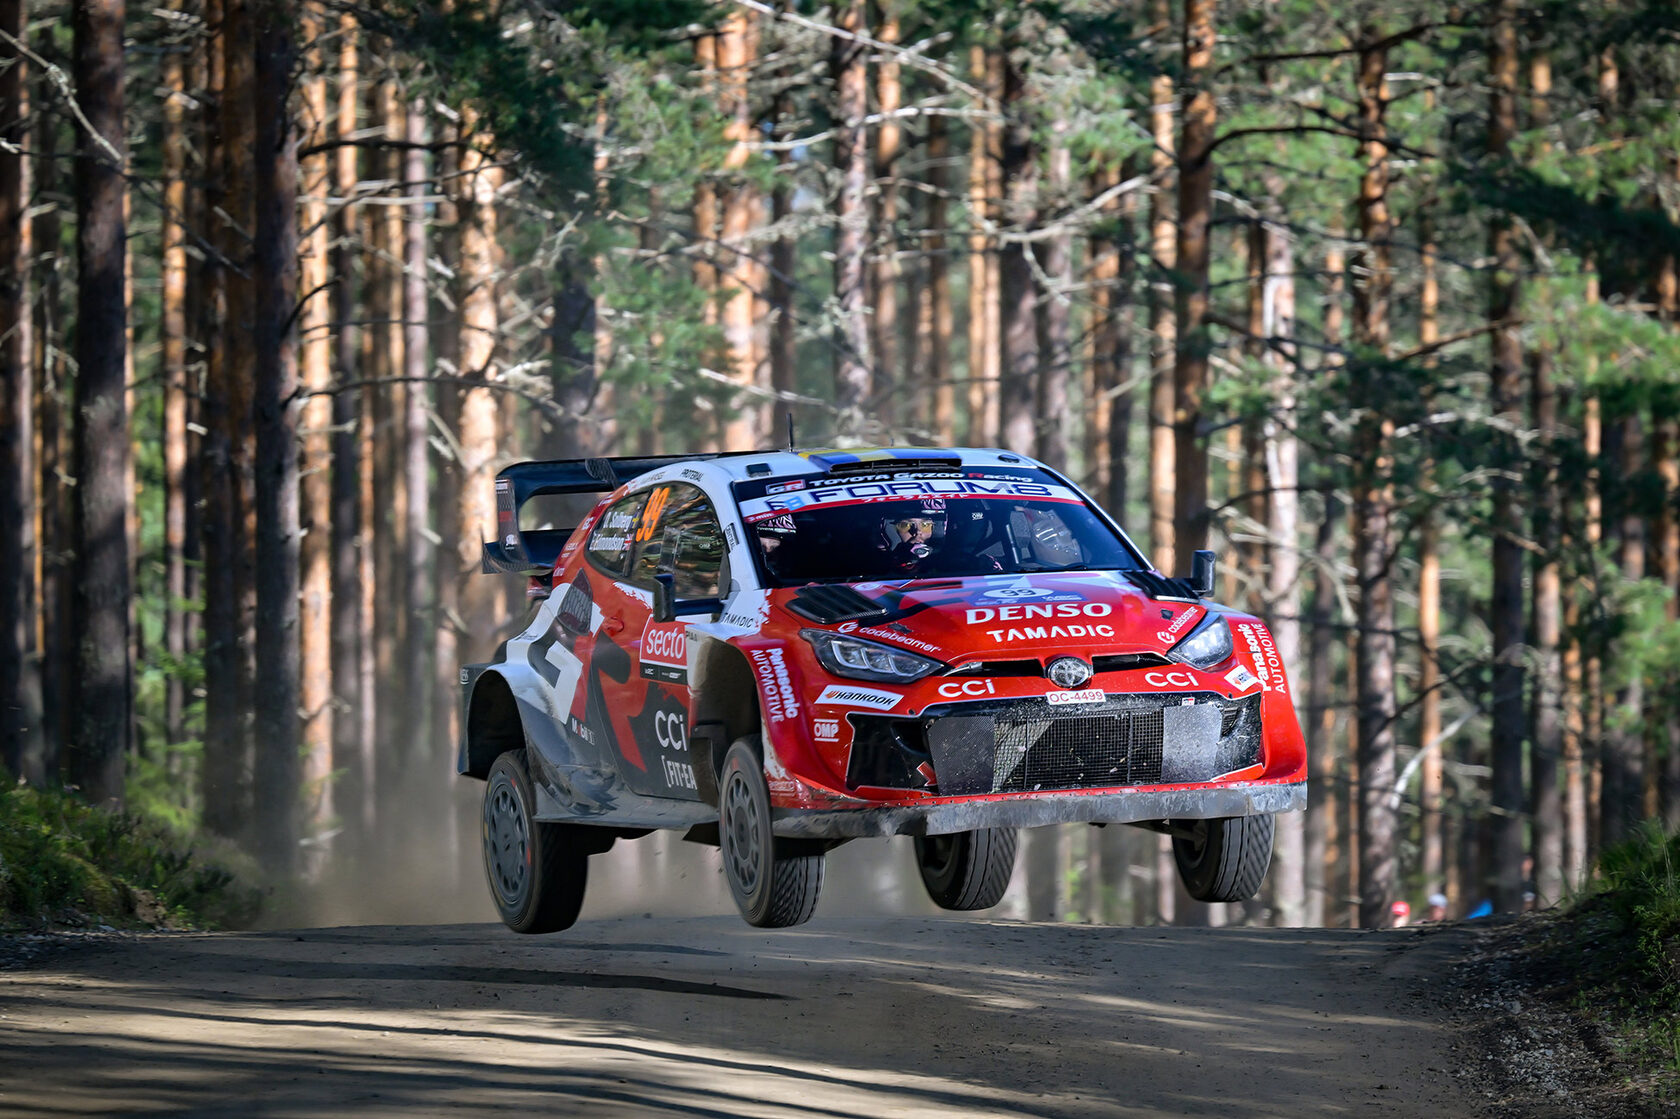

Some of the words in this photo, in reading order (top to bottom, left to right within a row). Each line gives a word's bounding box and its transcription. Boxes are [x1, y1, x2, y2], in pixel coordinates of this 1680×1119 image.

[808, 474, 890, 487] TOYOTA
[893, 472, 966, 480] GAZOO
[967, 473, 1034, 483] Racing
[809, 482, 1053, 502] FORUM8
[636, 487, 671, 542] 99
[1001, 588, 1037, 597] 99
[965, 602, 1113, 625] DENSO
[646, 627, 684, 660] secto
[859, 626, 942, 653] codebeamer
[985, 624, 1116, 643] TAMADIC
[1237, 622, 1272, 692] Panasonic
[1250, 622, 1286, 694] AUTOMOTIVE
[750, 649, 785, 723] AUTOMOTIVE
[766, 647, 801, 719] Panasonic
[1049, 690, 1104, 703] OC-4499
[813, 722, 839, 738] OMP
